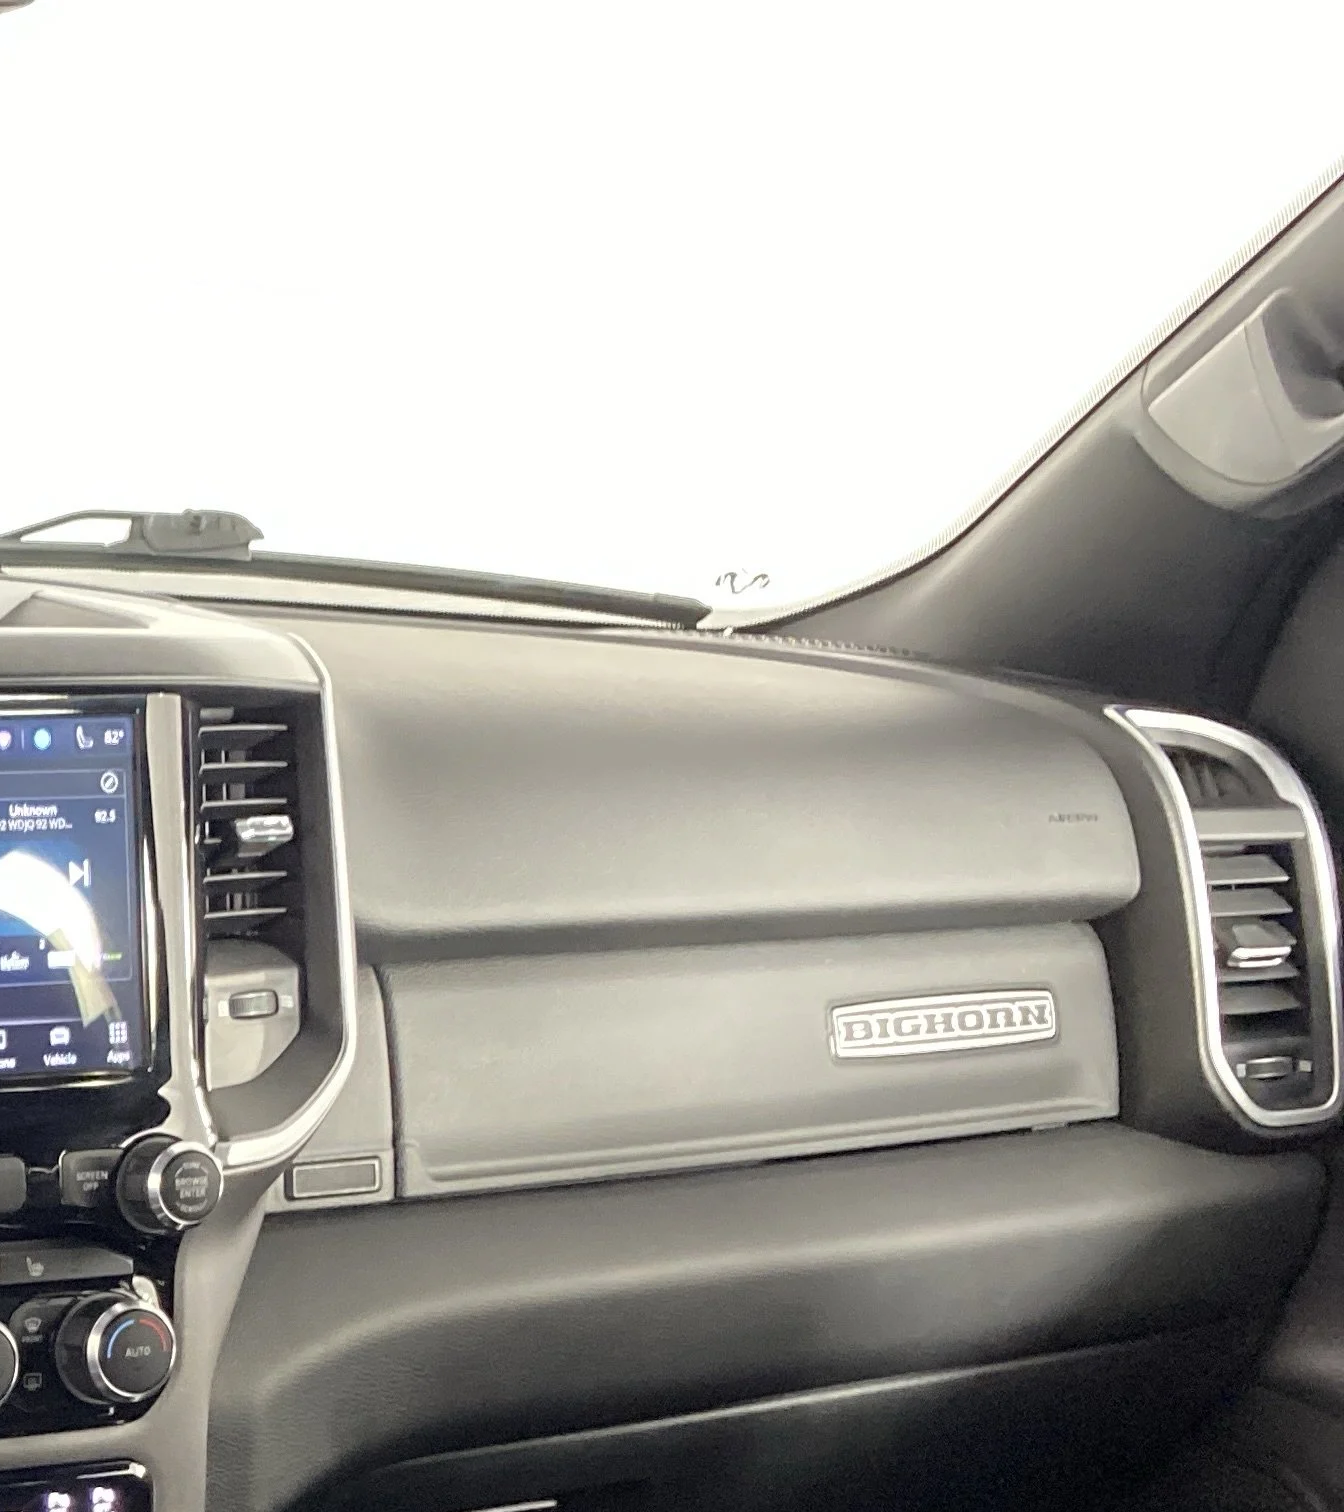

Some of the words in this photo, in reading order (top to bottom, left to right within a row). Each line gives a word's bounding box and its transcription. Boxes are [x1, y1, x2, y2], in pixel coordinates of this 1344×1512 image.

[9, 804, 58, 817] Unknown
[841, 1003, 1050, 1043] BIGHORN
[43, 1052, 77, 1067] Vehicle
[76, 1170, 108, 1182] SCREEN
[82, 1181, 99, 1192] OFF
[125, 1346, 151, 1358] AUTO
